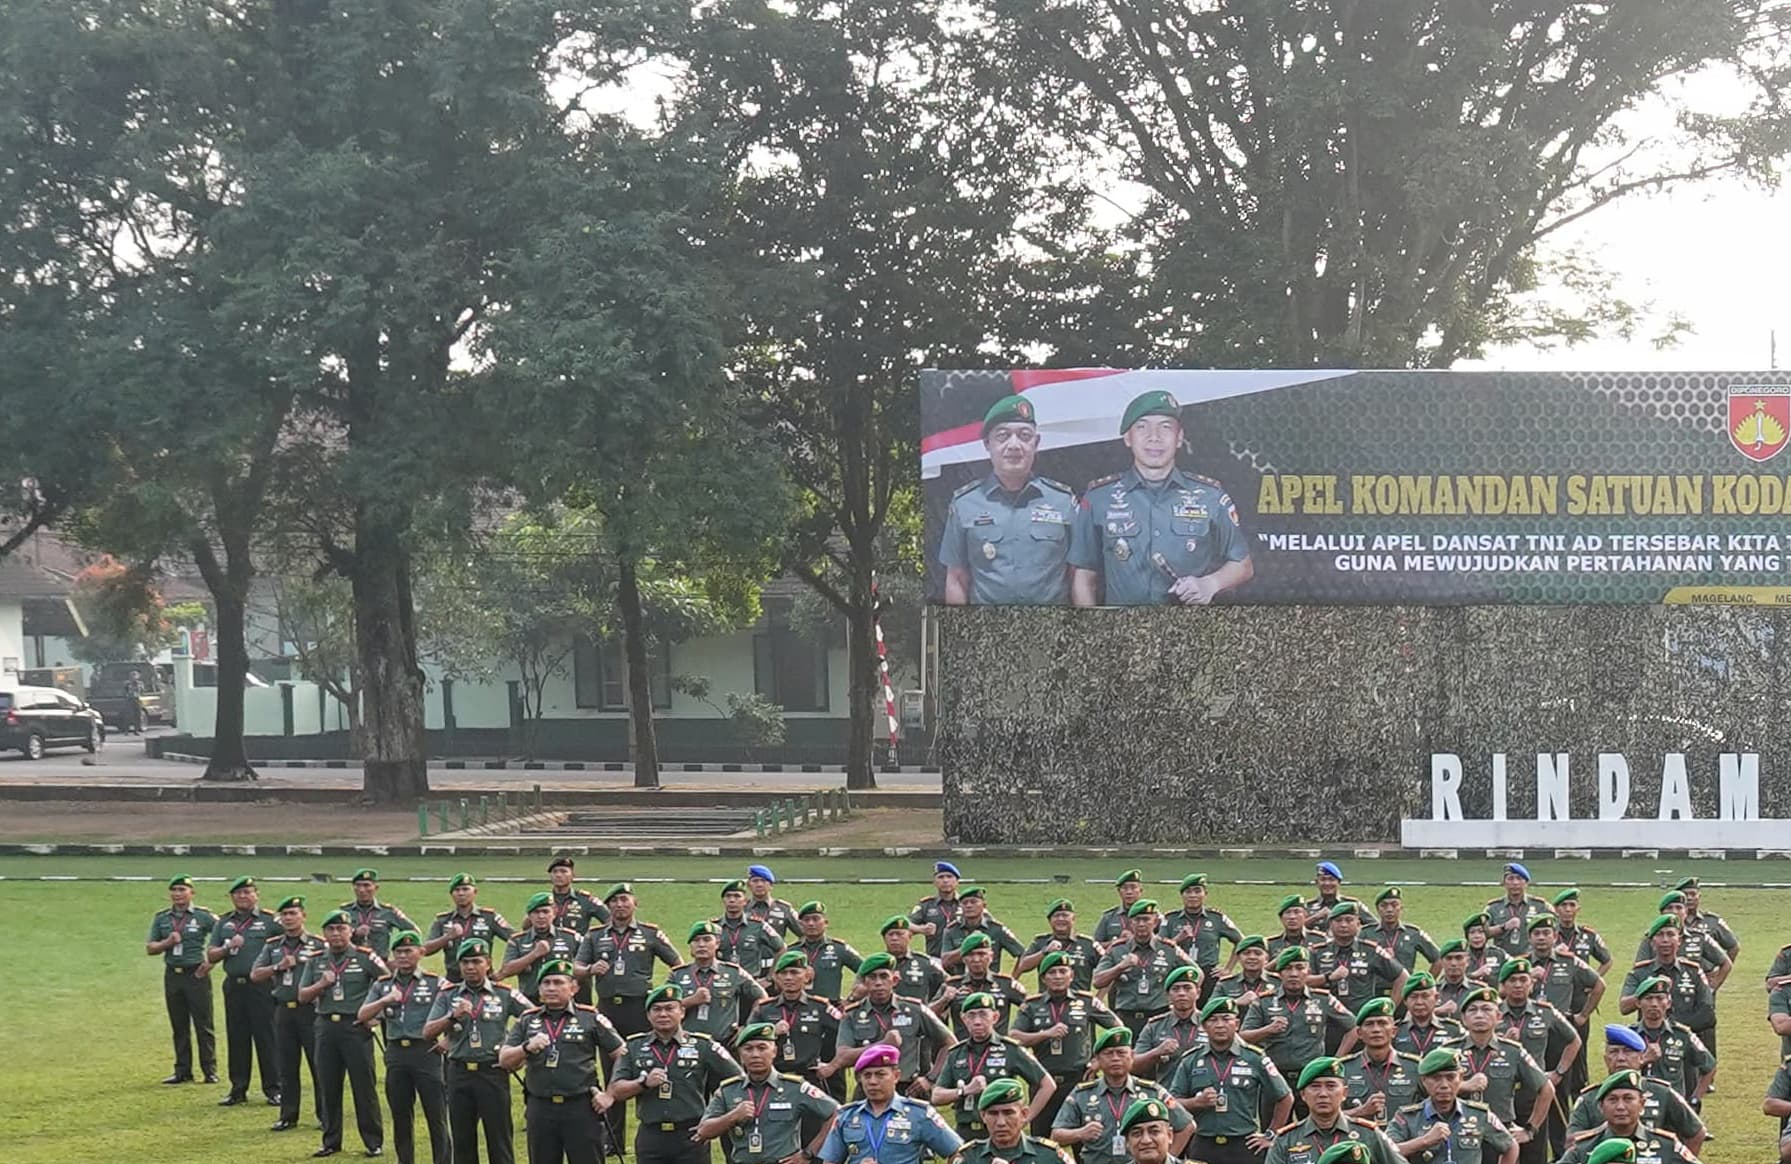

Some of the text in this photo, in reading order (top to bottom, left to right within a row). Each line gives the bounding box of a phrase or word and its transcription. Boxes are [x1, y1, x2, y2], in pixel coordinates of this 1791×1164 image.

[1257, 474, 1344, 514] APEL
[1352, 474, 1558, 514] KOMANDAN
[1567, 474, 1703, 514] SATUAN
[1372, 535, 1426, 551] APEL
[1432, 535, 1520, 551] DANSAT
[1525, 535, 1565, 551] TNI
[1572, 535, 1602, 551] AD
[1609, 535, 1721, 551] TERSEBAR
[1728, 535, 1780, 551] KITA
[1335, 555, 1397, 571] GUNA
[1404, 555, 1559, 571] MEWUJUDKAN
[1567, 555, 1713, 571] PERTAHANAN
[1720, 555, 1780, 571] YANG
[1691, 594, 1757, 604] MAGELANG,
[1430, 753, 1759, 820] RINDAM
